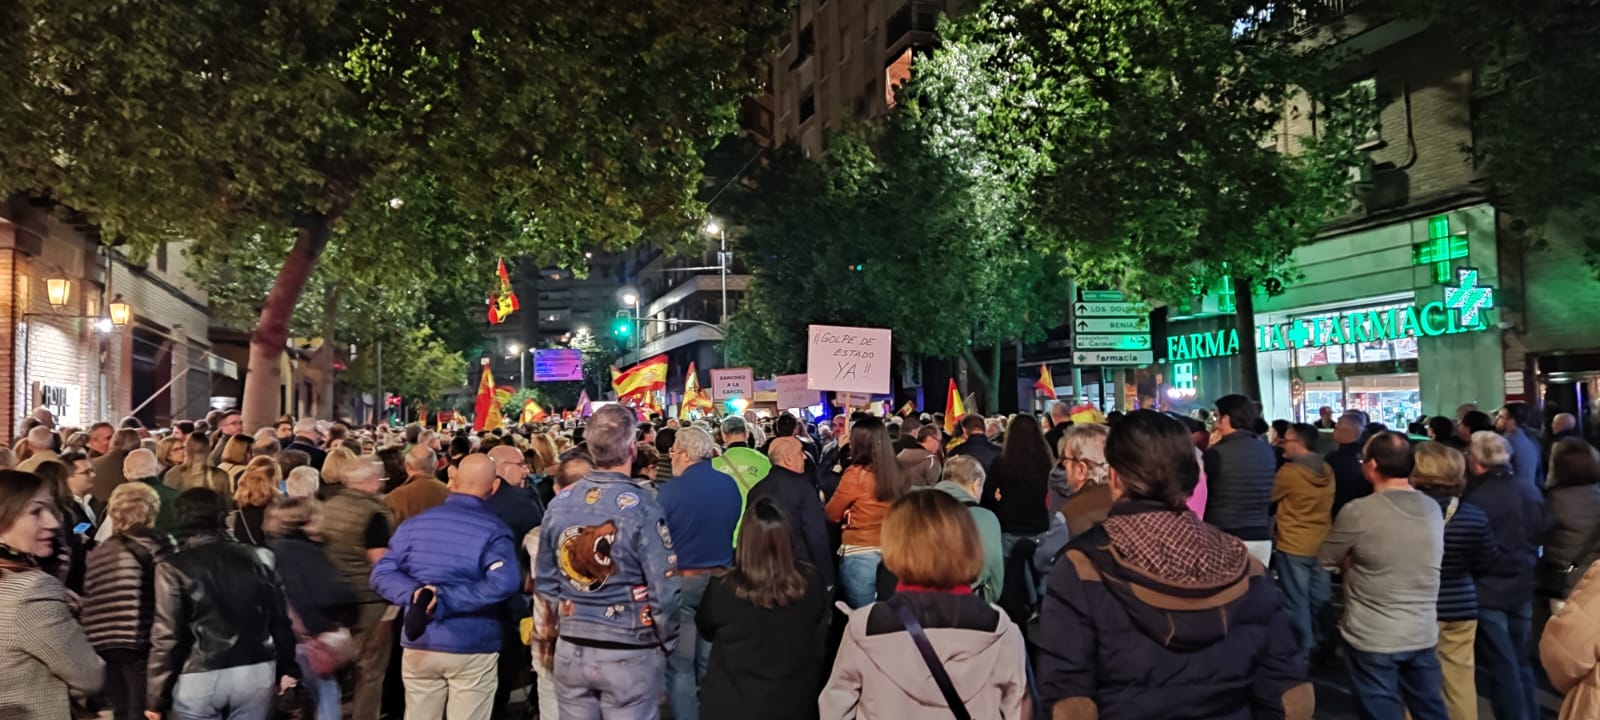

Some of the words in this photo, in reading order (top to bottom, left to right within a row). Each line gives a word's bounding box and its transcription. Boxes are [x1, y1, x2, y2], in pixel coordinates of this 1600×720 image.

[859, 336, 877, 346] DE
[1167, 324, 1286, 361] FARMAIA
[833, 348, 874, 359] ESTADO
[1096, 354, 1138, 362] farmacia
[834, 361, 856, 380] YA
